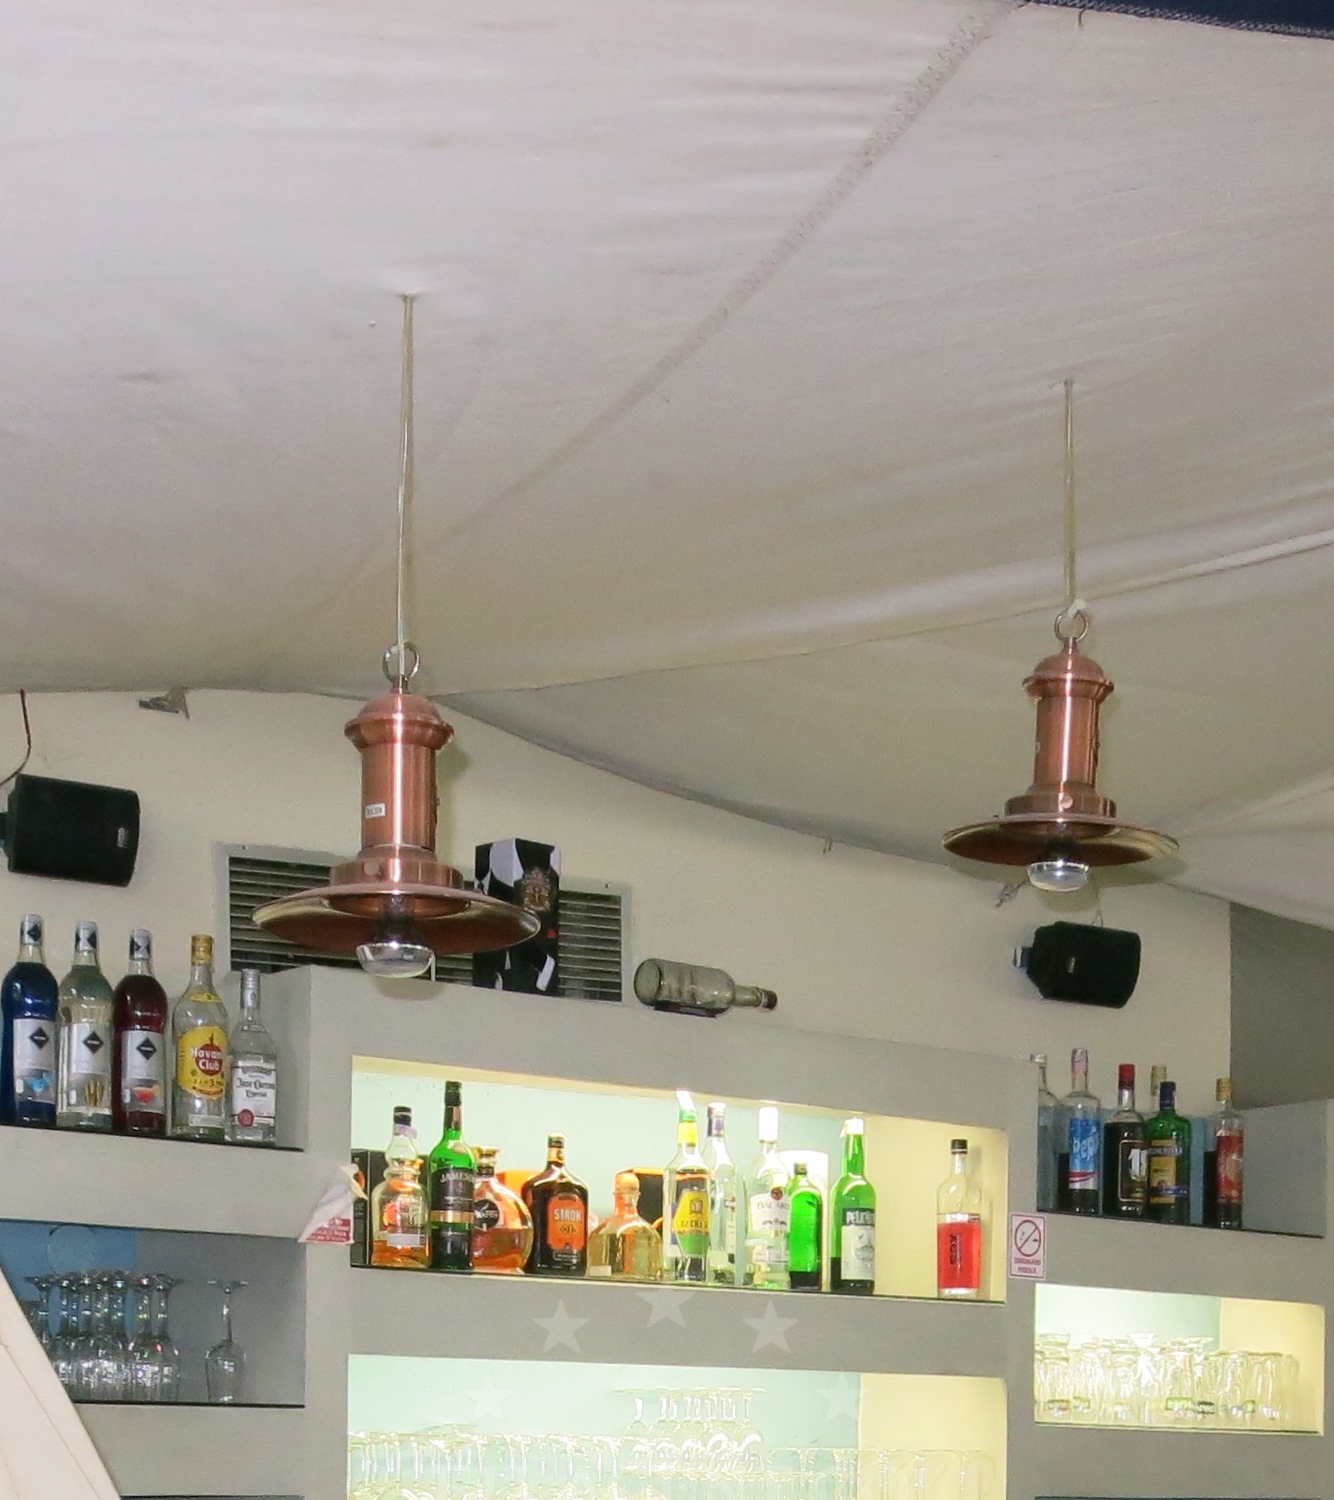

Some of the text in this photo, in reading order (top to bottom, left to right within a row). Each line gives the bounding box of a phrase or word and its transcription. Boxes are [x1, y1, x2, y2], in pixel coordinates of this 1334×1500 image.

[198, 1059, 220, 1071] Club
[757, 1201, 790, 1211] BACARD
[553, 1208, 583, 1221] STROH
